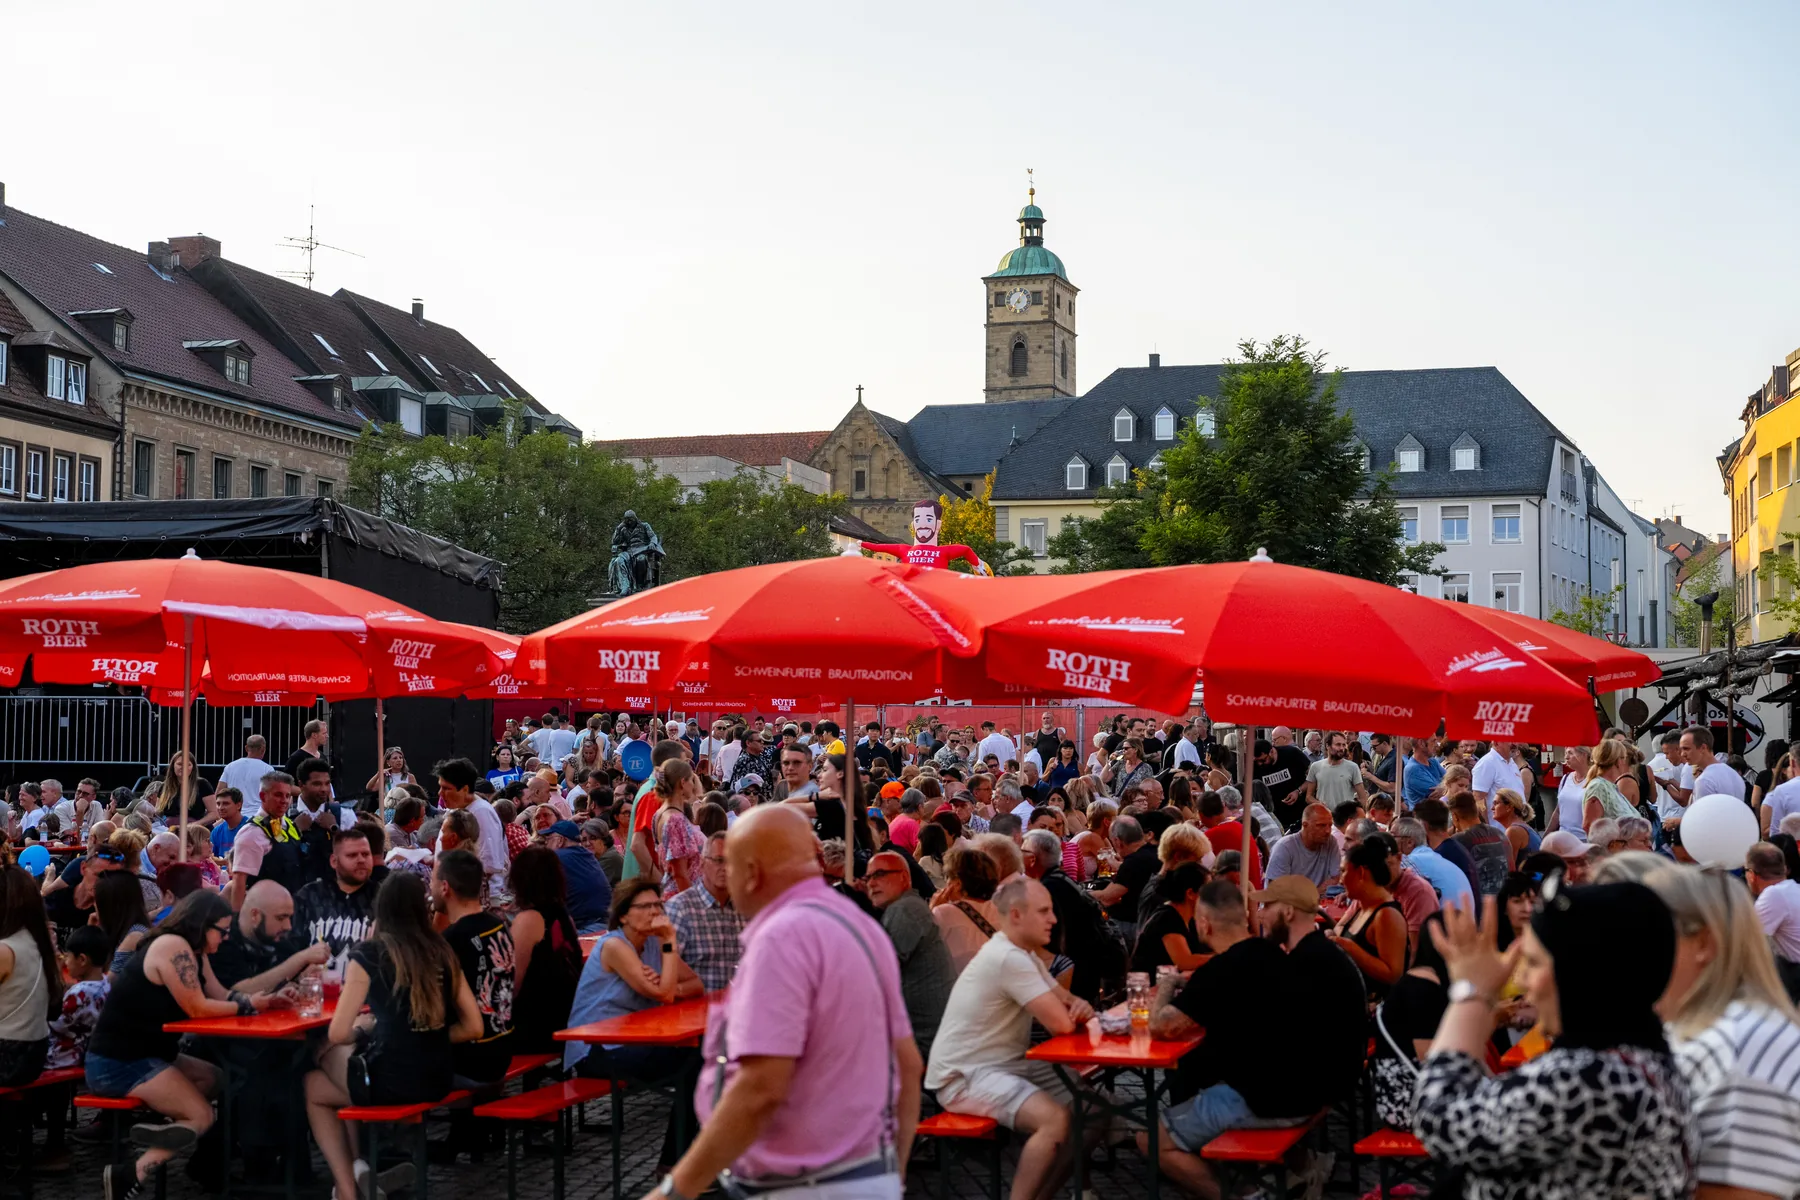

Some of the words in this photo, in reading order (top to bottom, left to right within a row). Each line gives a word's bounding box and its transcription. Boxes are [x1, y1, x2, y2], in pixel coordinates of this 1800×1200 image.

[907, 549, 940, 557] ROTH
[21, 618, 101, 635] ROTH
[43, 635, 87, 647] BIER
[388, 638, 436, 659] ROTH
[393, 655, 420, 669] BIER
[598, 649, 661, 671] ROTH
[1046, 648, 1131, 682] ROTH
[614, 669, 648, 684] BIER
[734, 666, 822, 679] SCHWEINFURTER
[828, 668, 913, 681] BRAUTRADITION
[497, 686, 519, 694] BIER
[1063, 672, 1112, 693] BIER
[254, 693, 280, 702] BIER
[771, 698, 796, 707] ROTH
[1226, 693, 1317, 711] SCHWEINFURTER
[1323, 700, 1413, 718] BRAUTRADITION
[1473, 701, 1534, 723] ROTH
[1482, 720, 1515, 736] BIER
